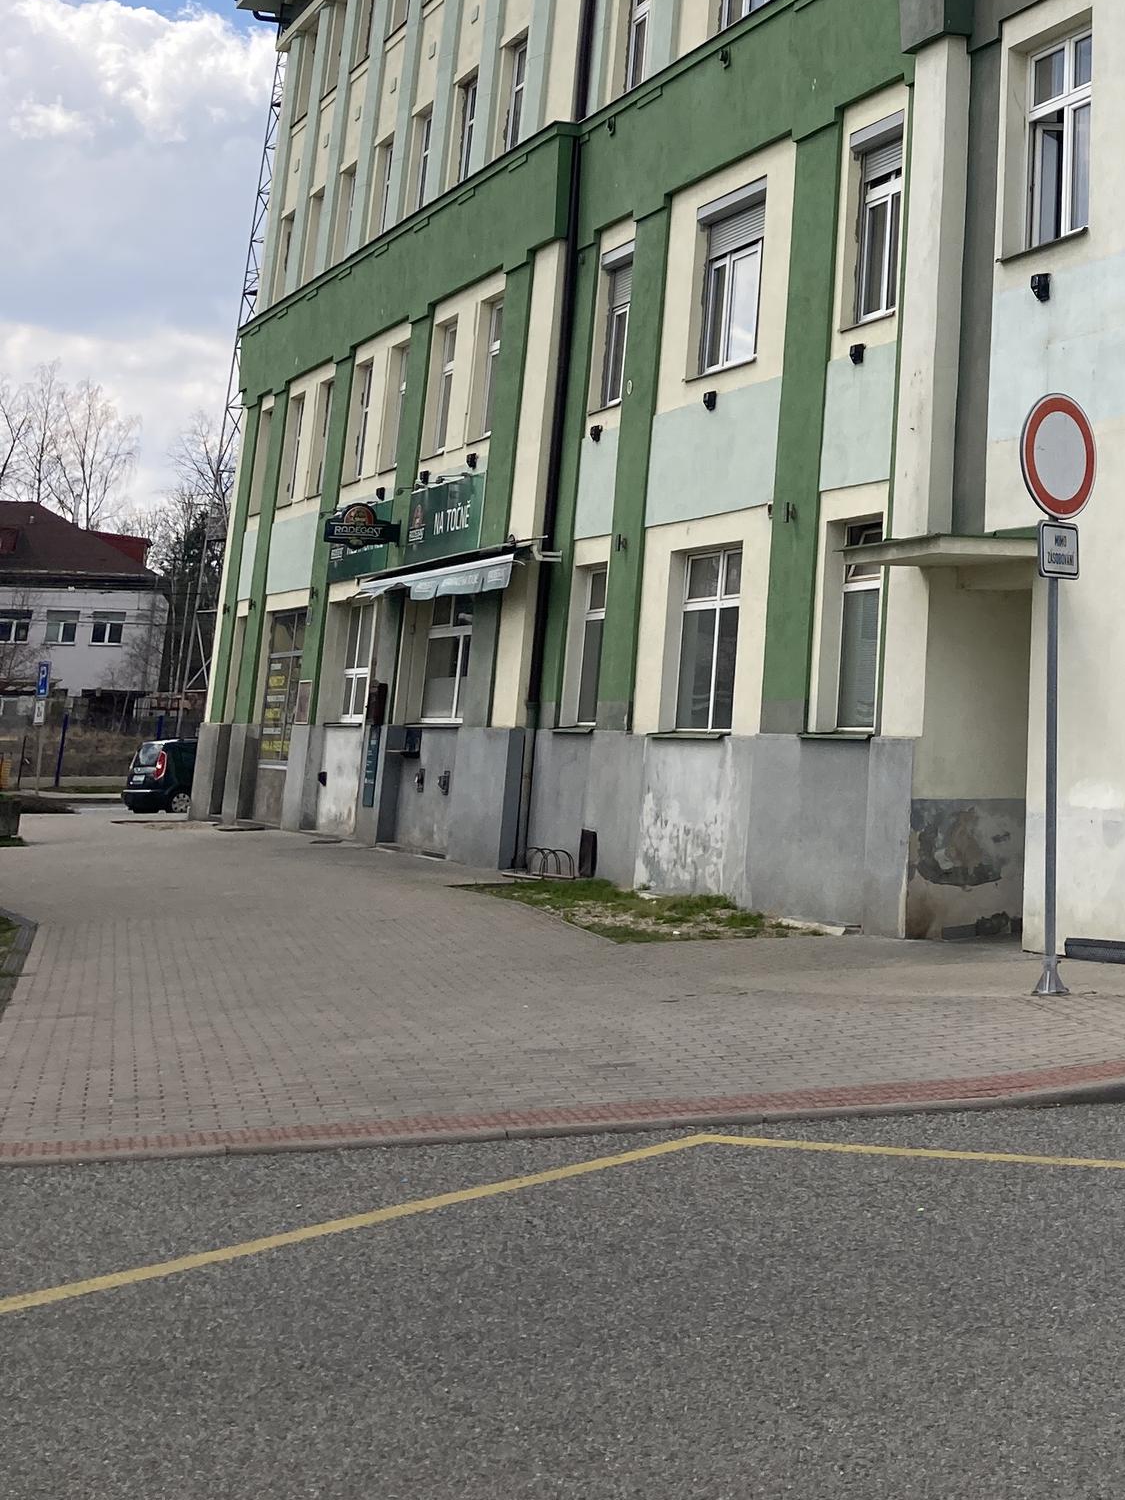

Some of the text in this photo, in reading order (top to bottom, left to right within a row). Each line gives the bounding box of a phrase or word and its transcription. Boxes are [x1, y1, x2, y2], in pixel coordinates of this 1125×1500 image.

[433, 500, 471, 536] NA TOČNĚ
[334, 525, 383, 538] RADEGAST
